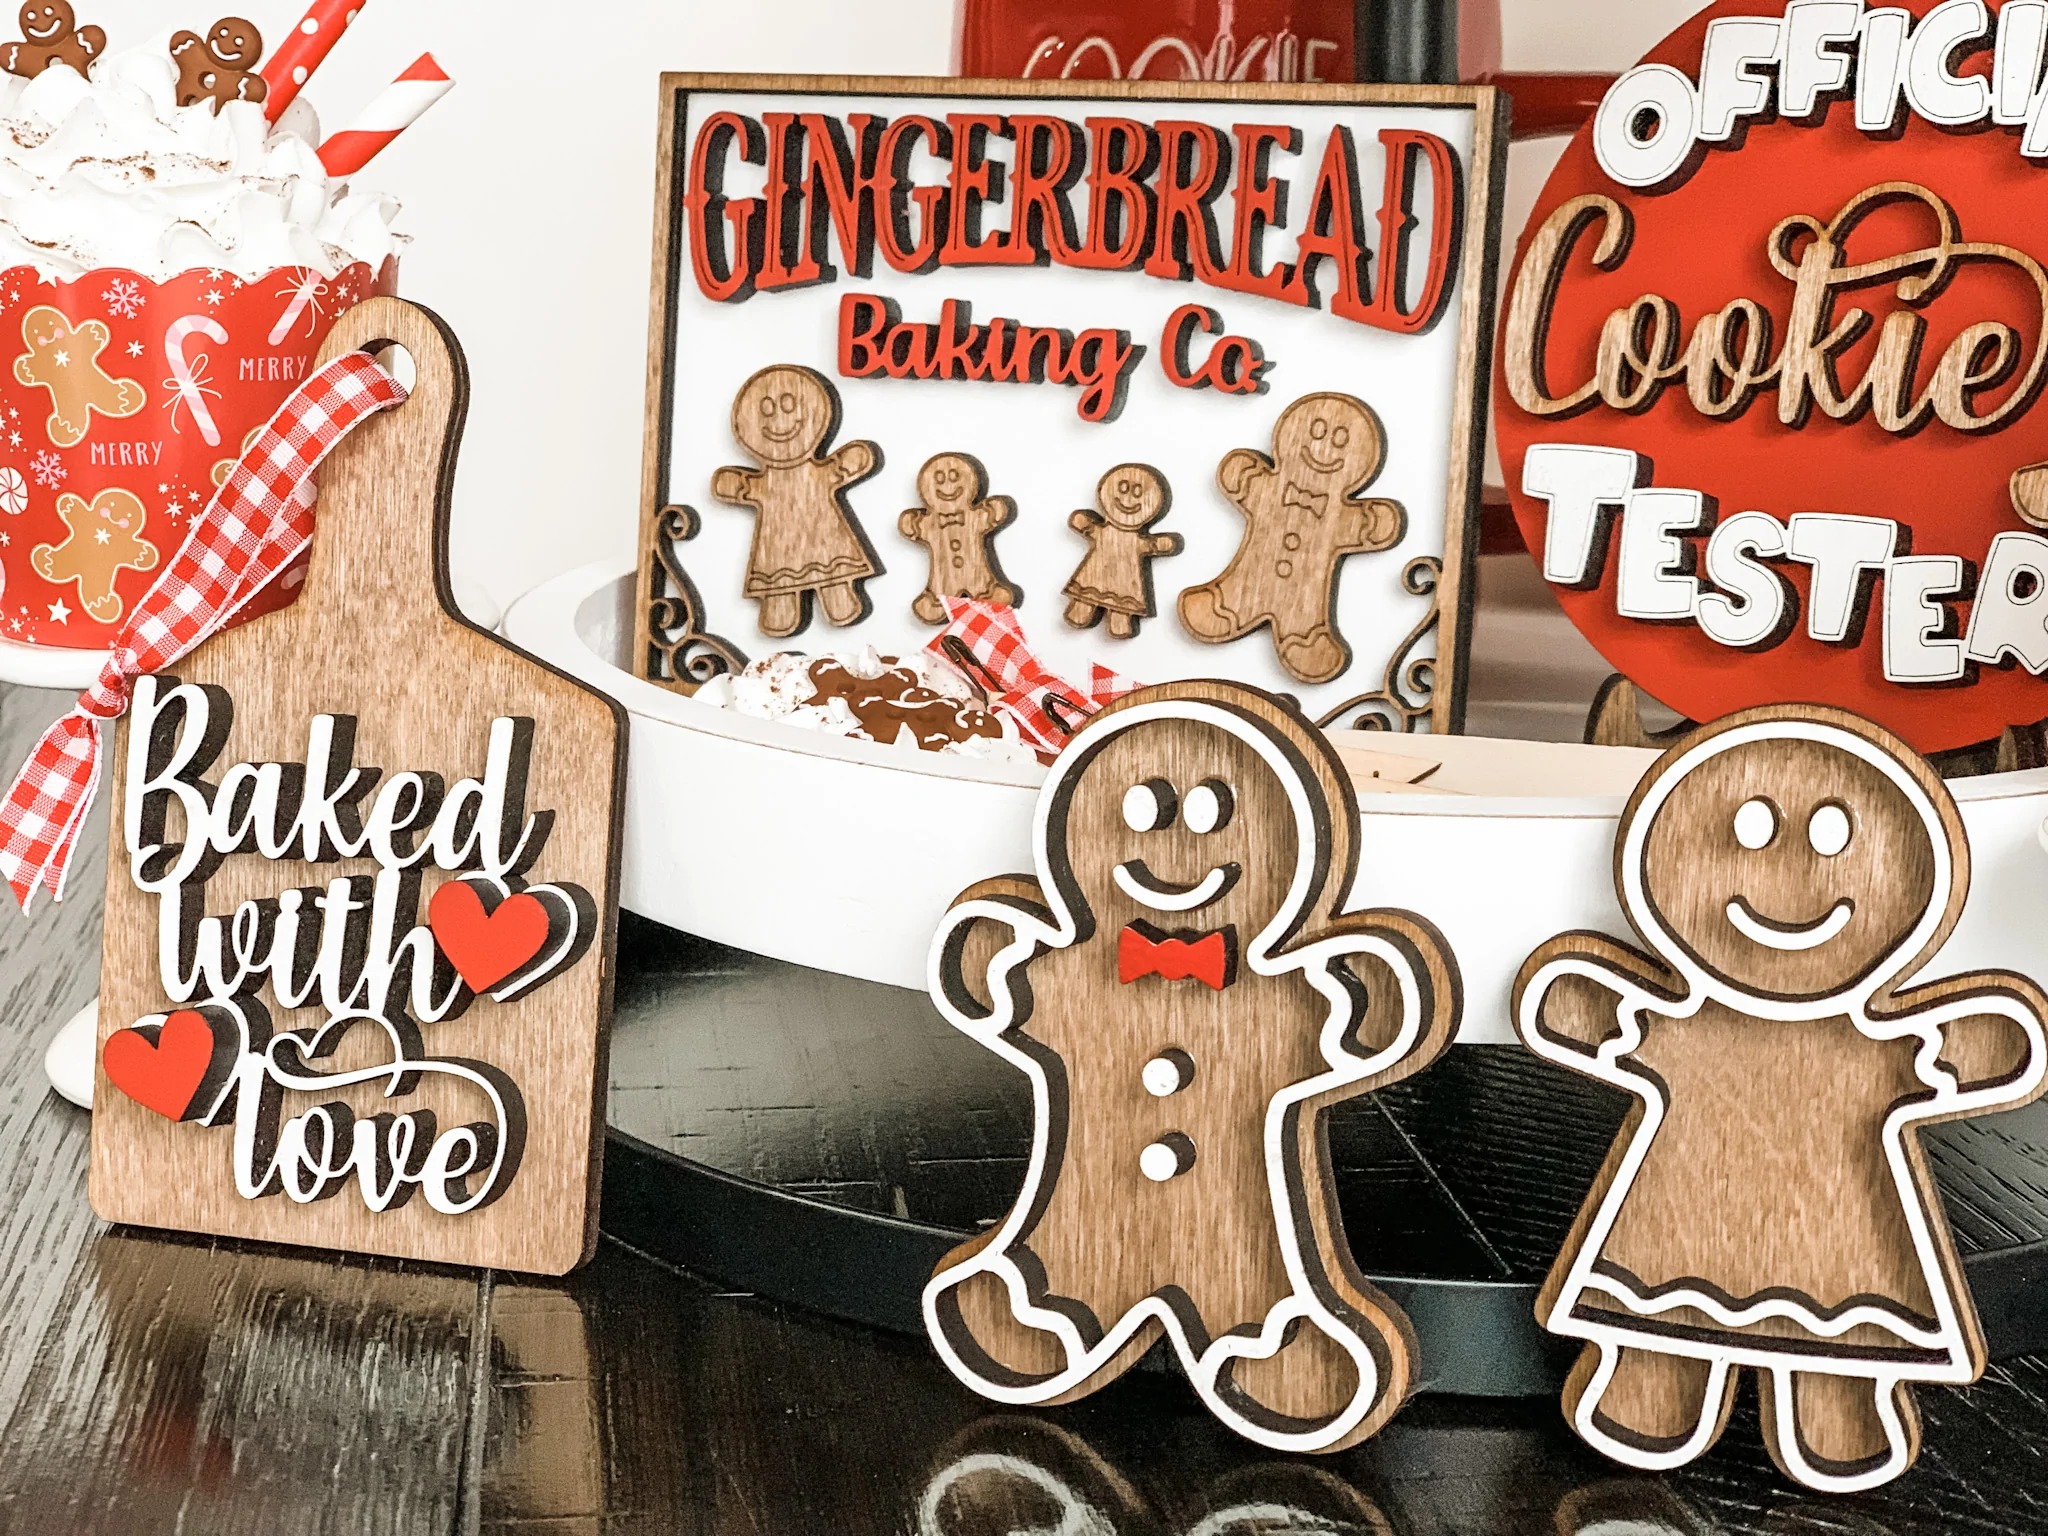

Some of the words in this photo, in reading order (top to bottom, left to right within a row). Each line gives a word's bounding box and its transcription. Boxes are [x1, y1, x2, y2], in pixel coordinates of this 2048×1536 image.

[1593, 0, 2048, 187] OFFICI
[685, 110, 1459, 335] GINGERBREAD
[1504, 182, 2048, 431] Cookie
[91, 441, 162, 466] MERRY
[239, 355, 307, 381] MERRY
[838, 294, 1134, 422] Baking
[1522, 444, 2048, 683] TESTER
[125, 675, 537, 893] Baked
[159, 869, 464, 1023] with
[233, 1009, 508, 1215] love
